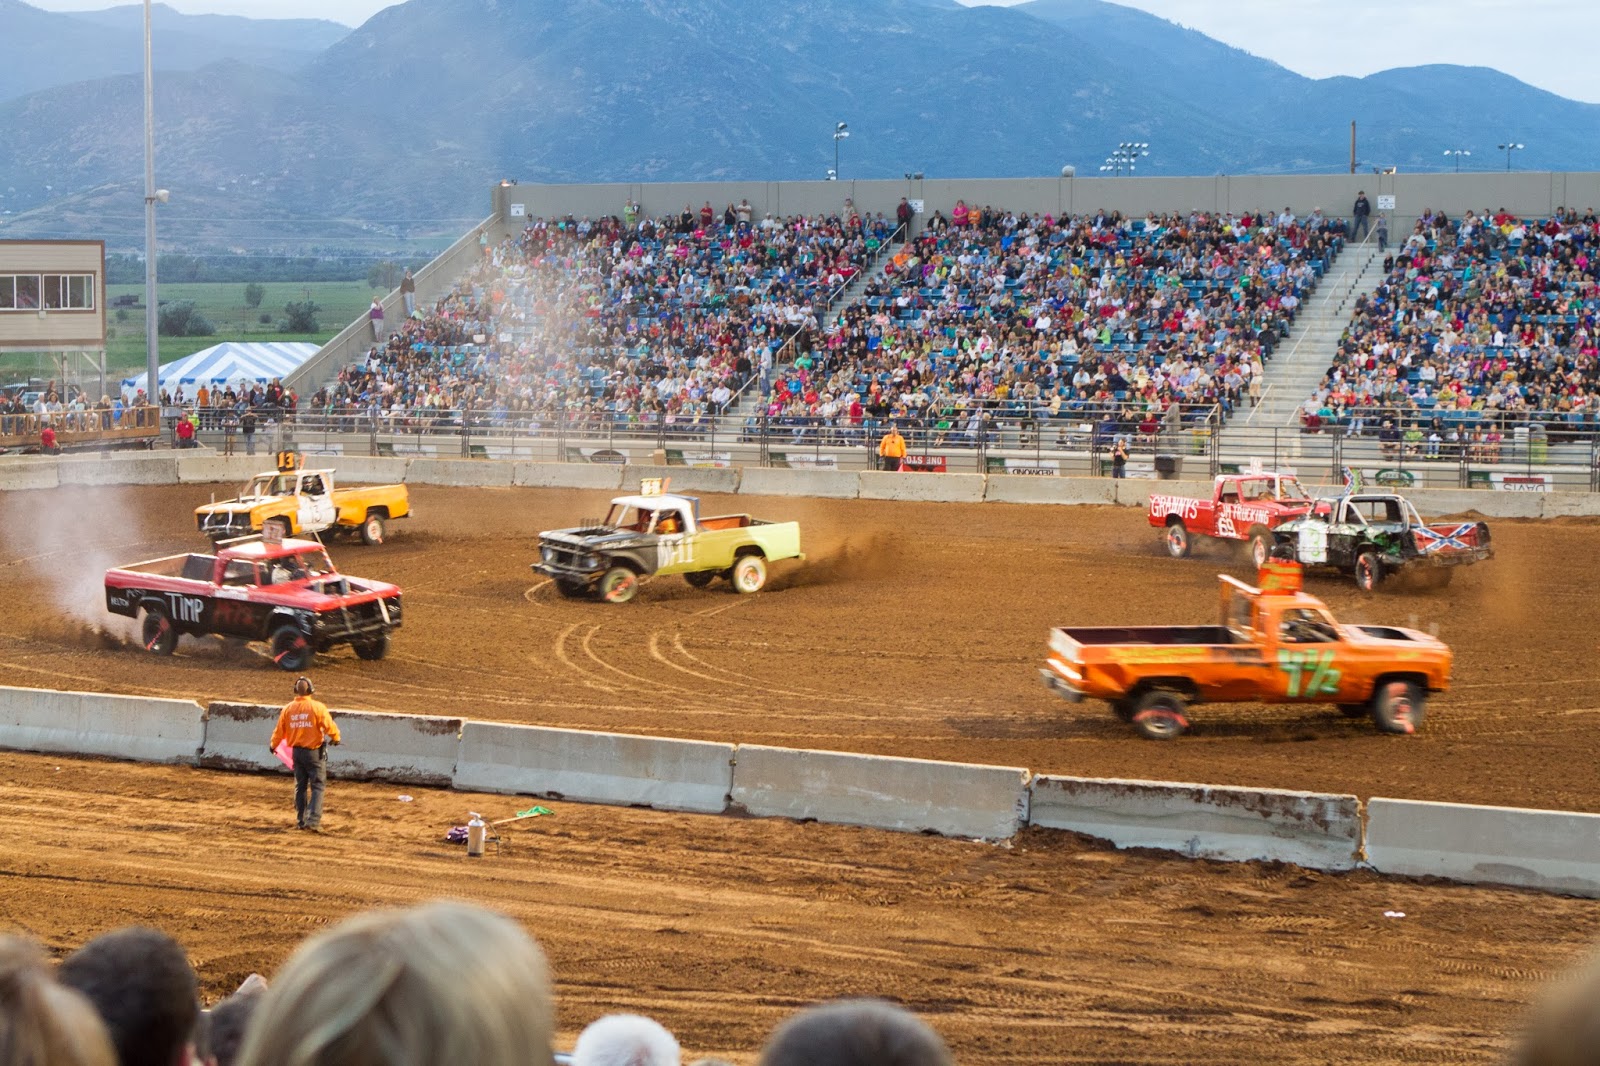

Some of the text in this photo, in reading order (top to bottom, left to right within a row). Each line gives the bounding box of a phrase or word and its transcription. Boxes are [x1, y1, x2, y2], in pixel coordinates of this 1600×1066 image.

[278, 451, 294, 468] 13
[903, 456, 942, 464] ONE STO
[1503, 483, 1546, 492] DAVIS
[1150, 495, 1199, 519] GRANNYS
[1233, 504, 1270, 524] TRUCKING
[1217, 517, 1237, 537] 69
